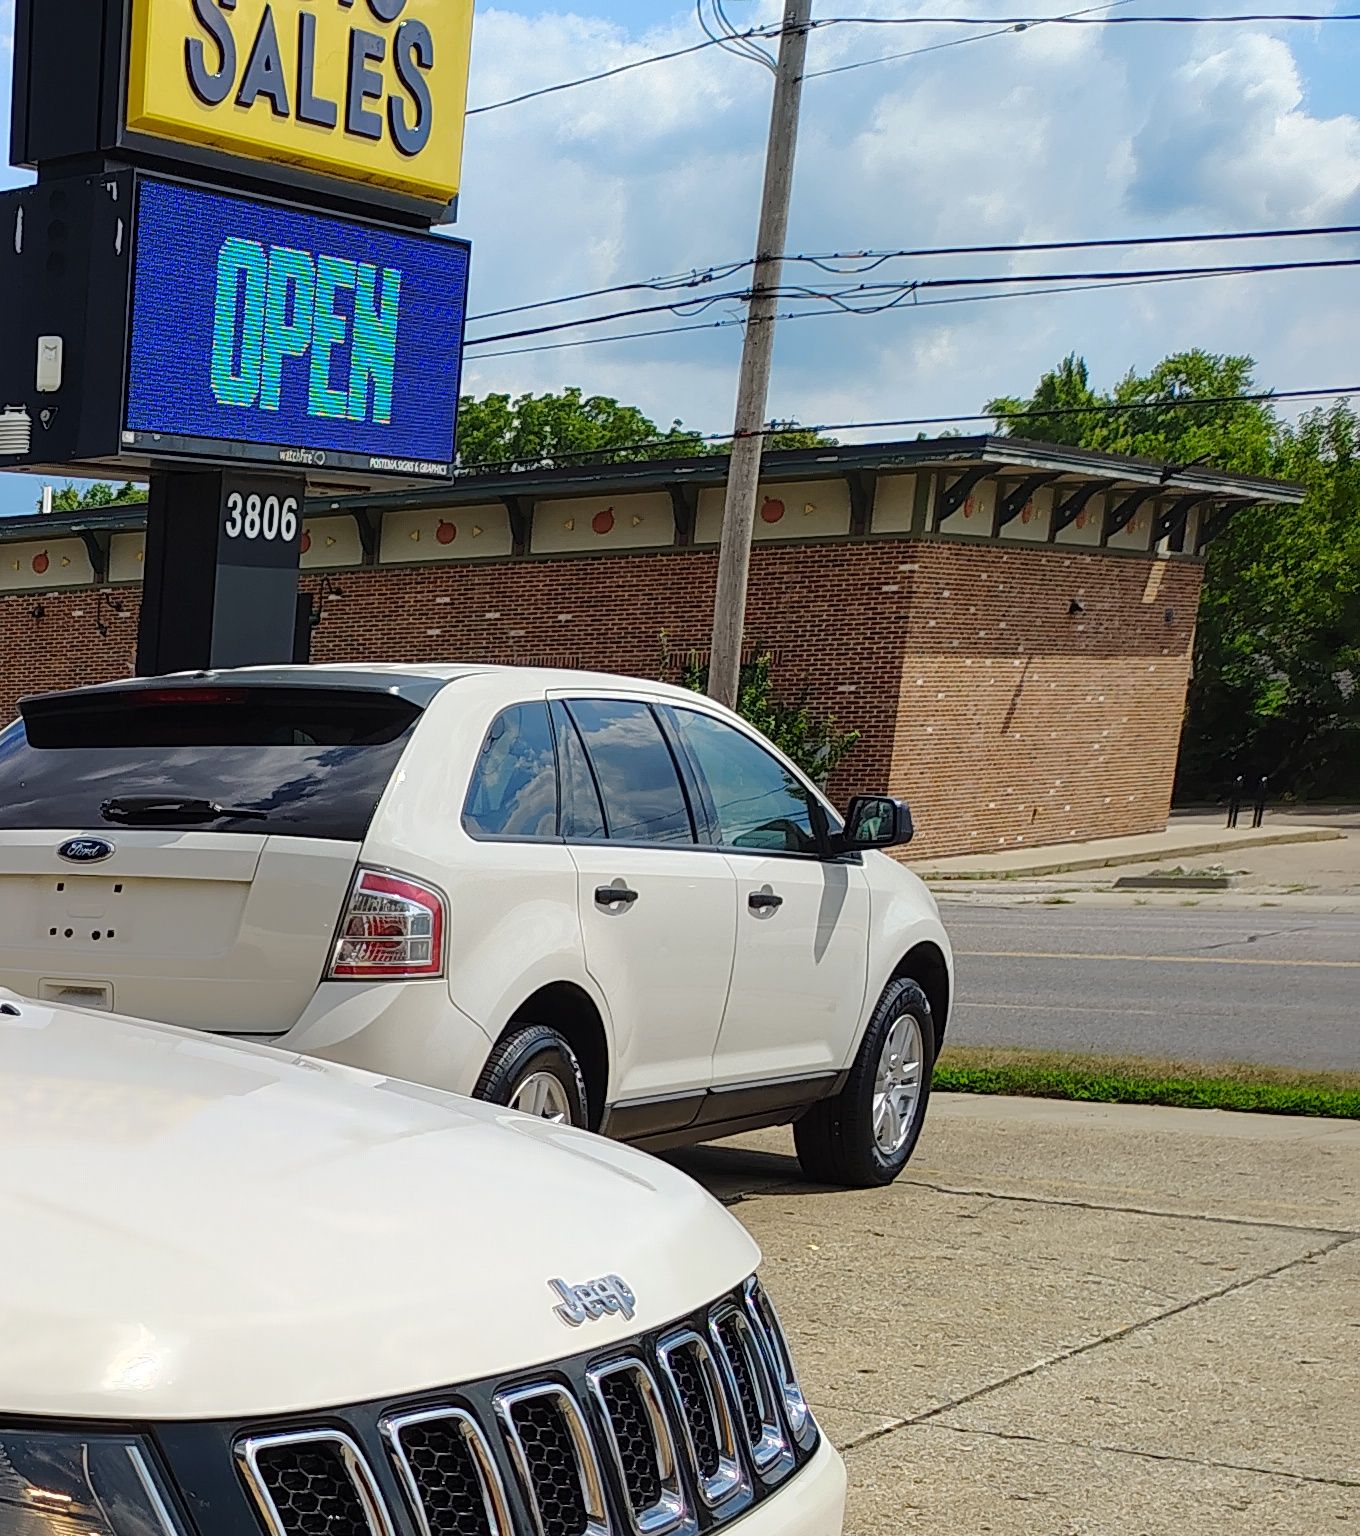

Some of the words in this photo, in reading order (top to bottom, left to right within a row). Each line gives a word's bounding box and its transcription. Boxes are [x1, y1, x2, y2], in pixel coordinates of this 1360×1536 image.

[184, 0, 434, 157] SALES
[210, 236, 402, 424] OPEN
[225, 492, 298, 542] 3806
[66, 841, 101, 857] Ford
[546, 1273, 637, 1328] Jeep
